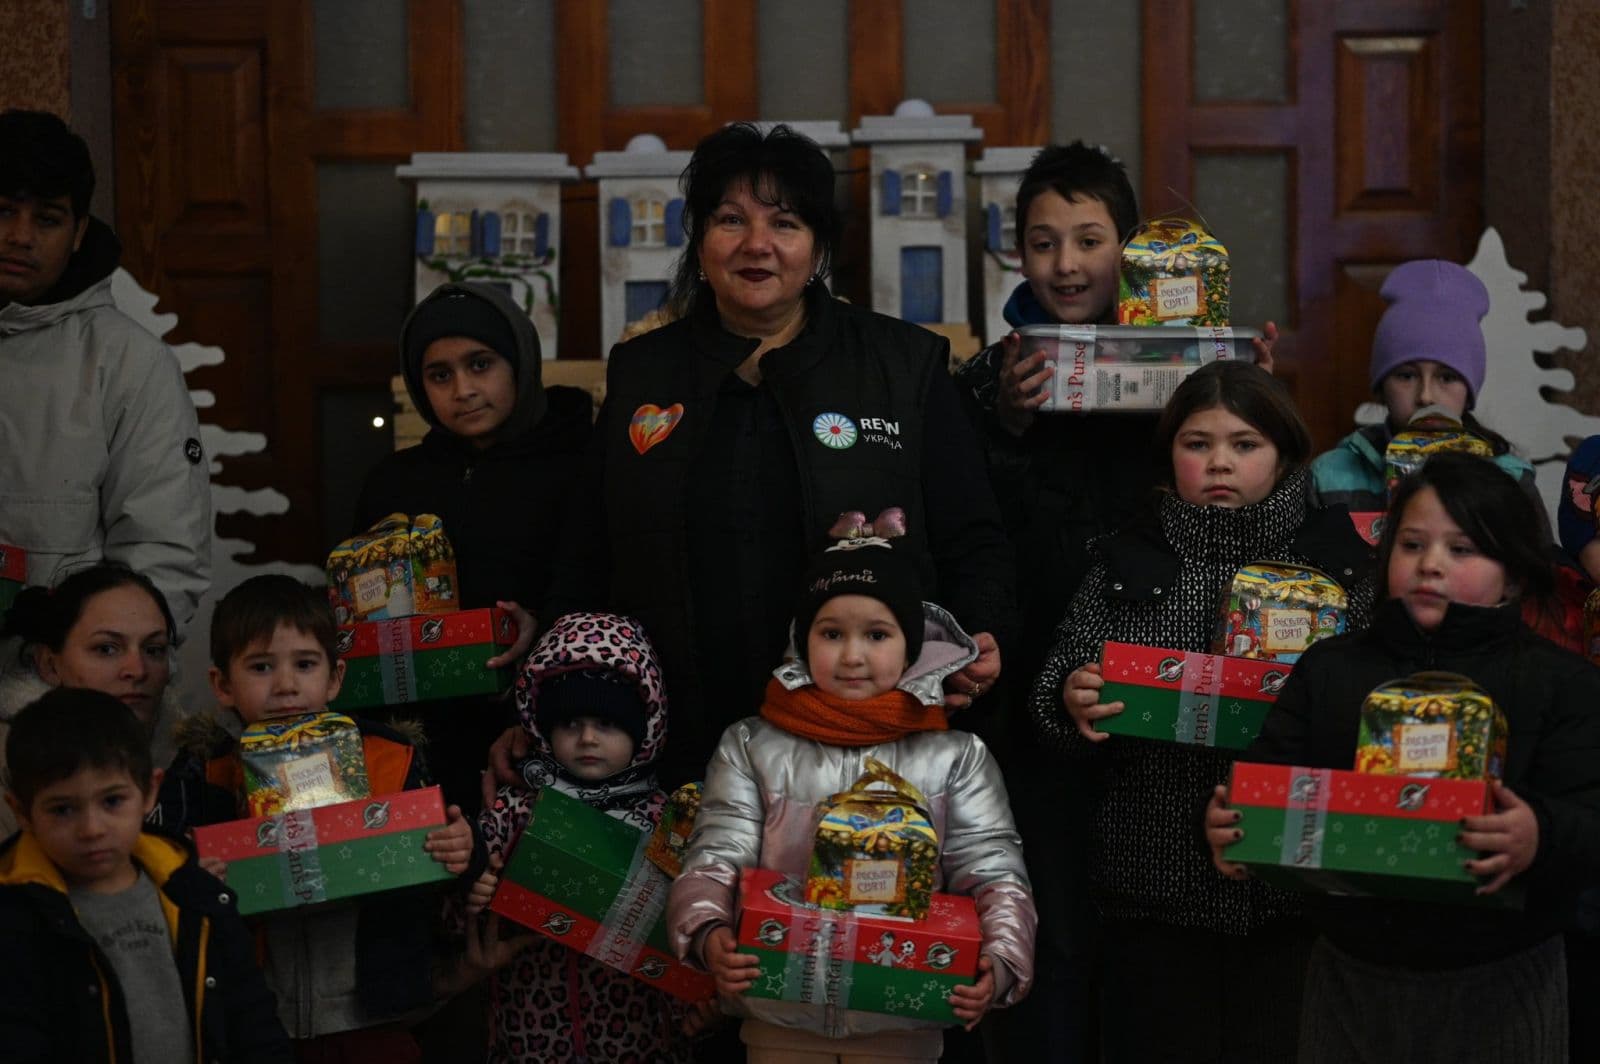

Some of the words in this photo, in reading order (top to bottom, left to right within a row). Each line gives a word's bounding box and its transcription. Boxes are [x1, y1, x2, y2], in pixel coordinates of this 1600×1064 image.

[1068, 342, 1086, 386] Purse
[809, 569, 878, 592] Minnie
[1192, 703, 1210, 745] tan's
